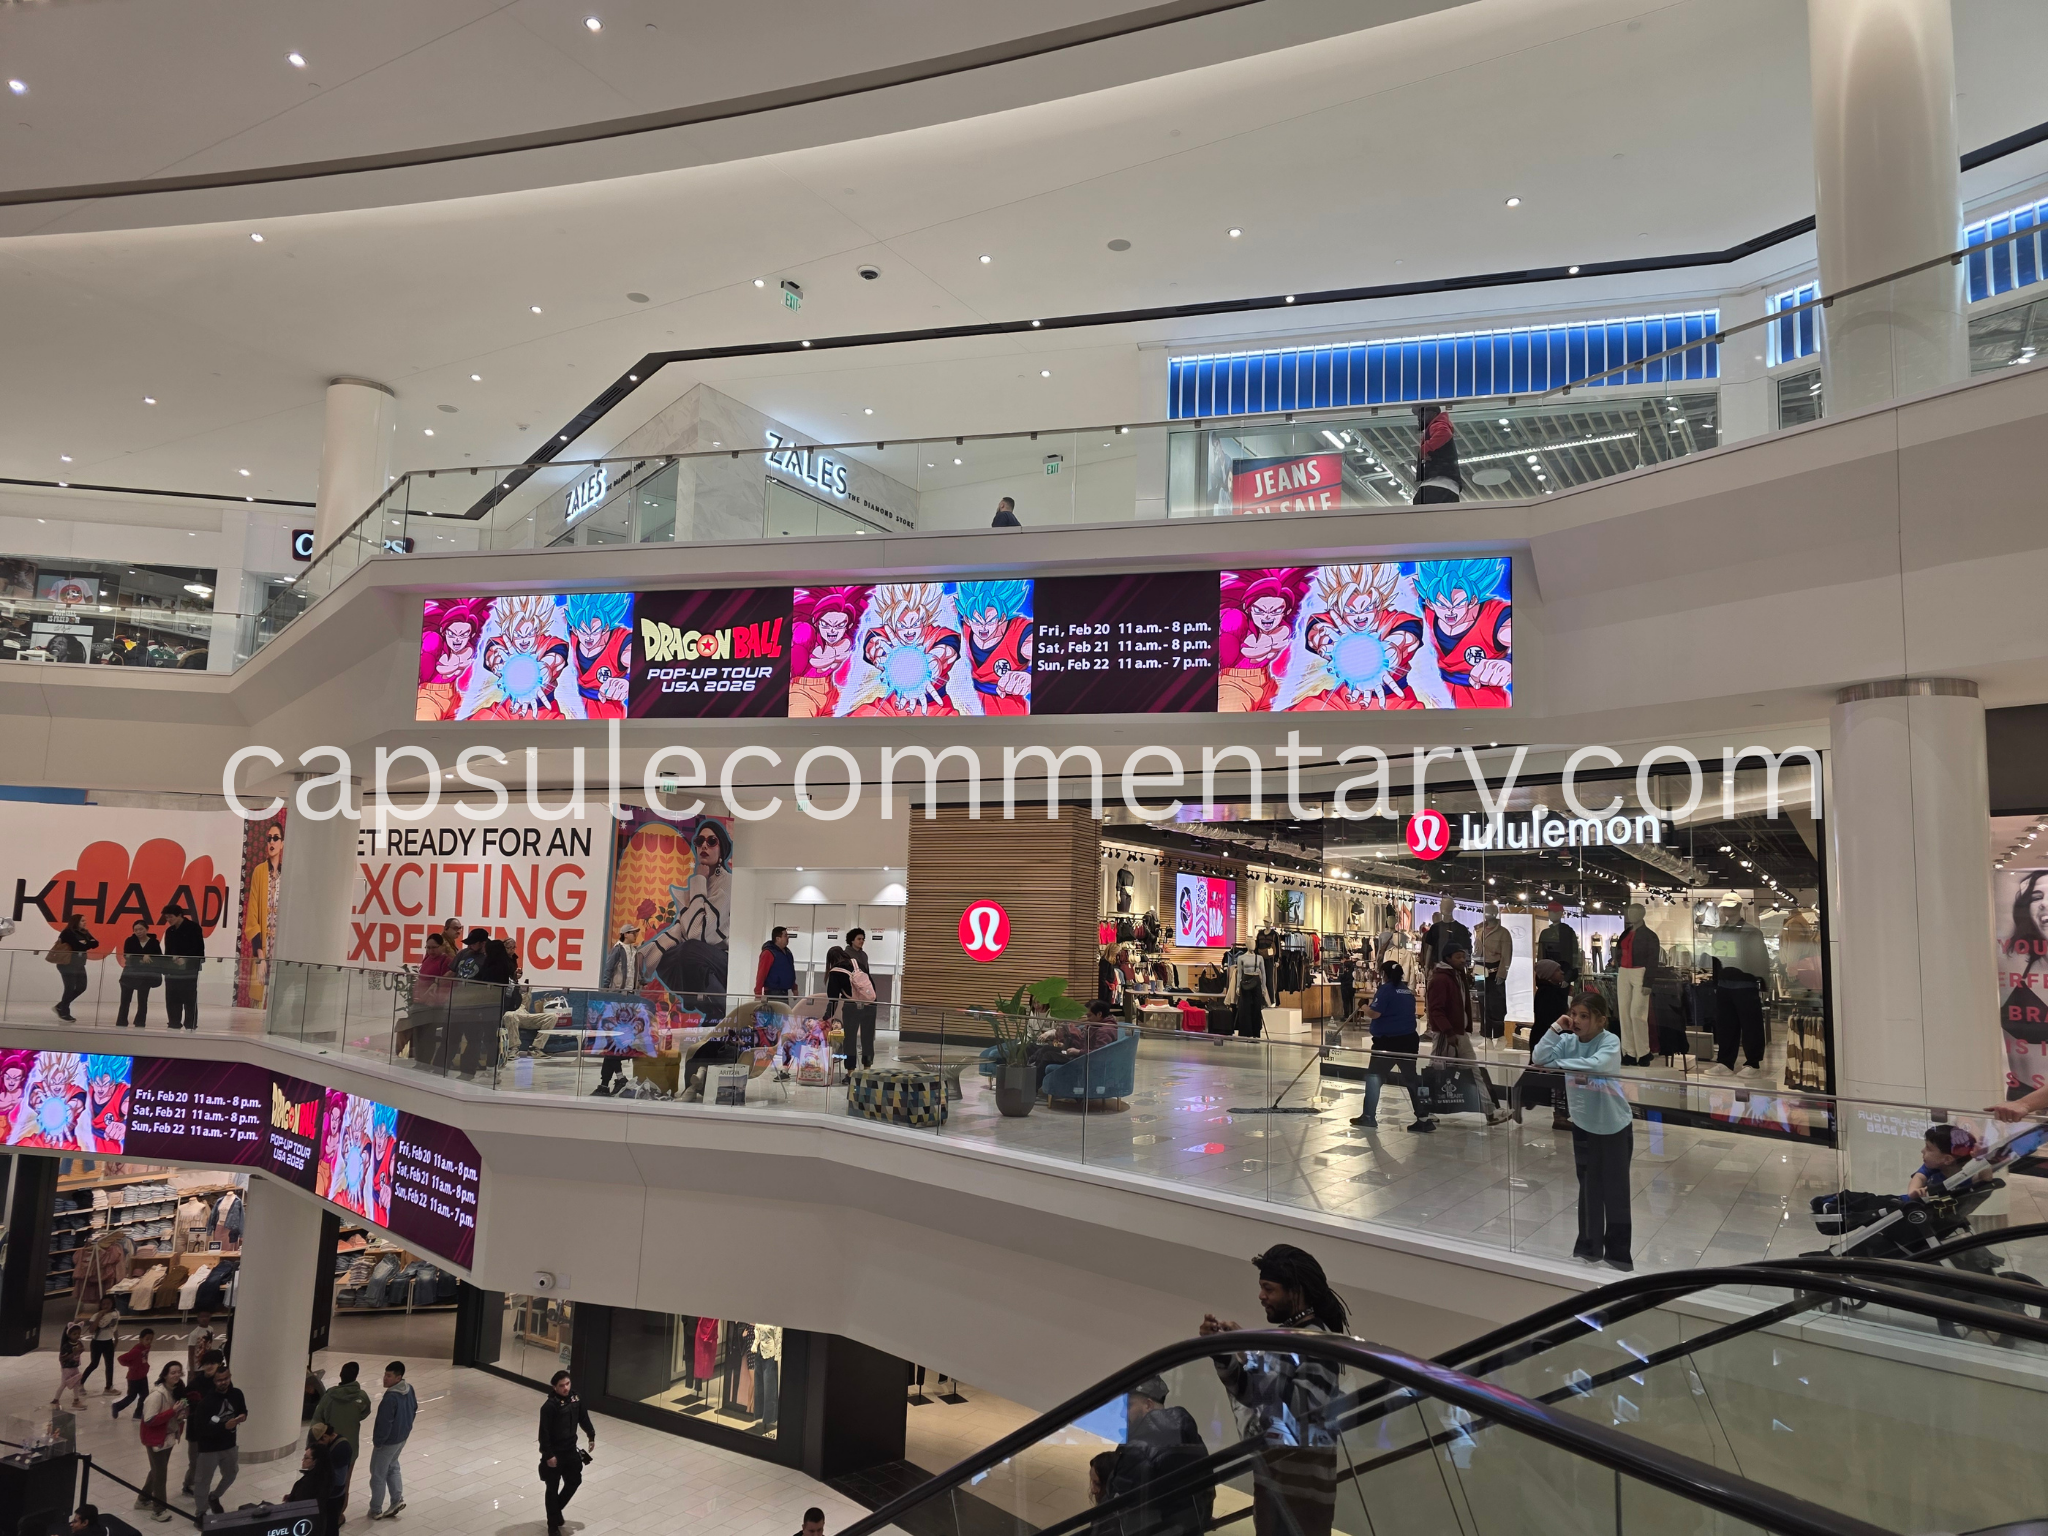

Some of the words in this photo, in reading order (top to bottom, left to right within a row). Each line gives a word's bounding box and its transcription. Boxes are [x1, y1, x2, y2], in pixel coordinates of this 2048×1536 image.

[785, 292, 798, 311] EXIT
[769, 431, 847, 494] ZALES
[848, 492, 860, 503] THE
[864, 500, 893, 519] DIAMOND
[1047, 463, 1059, 475] EXIT
[1254, 460, 1321, 498] JEANS
[564, 468, 603, 520] ZALES
[641, 617, 731, 661] DRAGON
[732, 617, 783, 659] BALL
[1039, 624, 1065, 638] Fri,
[1069, 623, 1092, 636] Feb
[1093, 623, 1110, 635] 20
[1118, 622, 1132, 634] 11
[1135, 624, 1162, 634] a.m.
[1171, 621, 1180, 632] 8
[1183, 622, 1211, 635] p.m.
[1037, 642, 1065, 655] Sat,
[1068, 641, 1091, 653] Feb
[1093, 641, 1108, 652] 21
[1118, 640, 1132, 651] 11
[1134, 641, 1162, 651] a.m.
[1171, 639, 1180, 650] 8
[1183, 640, 1211, 652] p.m.
[647, 667, 718, 680] POP-UP
[721, 666, 773, 679] TOUR
[1037, 660, 1065, 672] Sun,
[1067, 658, 1091, 670] Feb
[1093, 658, 1109, 670] 22
[1118, 658, 1132, 669] 11
[1134, 659, 1162, 669] a.m.
[1172, 656, 1181, 668] 7
[1183, 657, 1211, 670] p.m.
[661, 681, 700, 693] USA
[704, 680, 756, 692] 2026
[356, 828, 381, 856] ET
[387, 827, 476, 857] READY
[482, 827, 541, 857] FOR
[545, 827, 592, 857] AN
[1462, 810, 1664, 850] lululemon
[12, 878, 230, 929] KHAADI
[351, 862, 588, 920] XCITING
[347, 922, 586, 971] XPENCE
[1999, 972, 2048, 989] ERF
[2008, 1005, 2048, 1023] BR
[135, 1089, 155, 1102] Fri,
[157, 1090, 175, 1102] Feb
[175, 1092, 188, 1102] 20
[194, 1093, 204, 1104] 11
[205, 1096, 226, 1106] a.m.
[232, 1096, 239, 1106] 8
[240, 1098, 261, 1109] p.m.
[271, 1081, 300, 1134] DRAGON
[298, 1099, 319, 1140] BALL
[133, 1105, 153, 1117] Sat,
[155, 1106, 173, 1118] Feb
[174, 1108, 186, 1118] 21
[192, 1109, 203, 1120] 11
[204, 1112, 224, 1121] a.m.
[230, 1112, 237, 1122] 8
[238, 1114, 260, 1126] p.m.
[131, 1121, 152, 1133] Sun,
[153, 1122, 171, 1134] Feb
[172, 1124, 185, 1134] 22
[190, 1125, 201, 1136] 11
[202, 1128, 223, 1138] a.m.
[229, 1128, 237, 1139] 7
[237, 1131, 258, 1141] p.m.
[270, 1133, 293, 1151] POP-UP
[293, 1142, 311, 1159] TOUR
[273, 1147, 286, 1163] USA
[286, 1154, 305, 1171] 2026
[399, 1140, 411, 1158] Fri,
[411, 1144, 423, 1161] Feb
[422, 1149, 431, 1164] 20
[433, 1153, 441, 1168] 11
[441, 1158, 454, 1173] a.m.
[458, 1162, 463, 1176] 8
[463, 1166, 478, 1181] p.m.
[396, 1161, 409, 1180] Sat,
[410, 1166, 421, 1183] Feb
[420, 1171, 429, 1186] 21
[432, 1175, 439, 1190] 11
[439, 1180, 453, 1195] a.m.
[456, 1184, 461, 1199] 8
[461, 1189, 476, 1205] p.m.
[394, 1182, 407, 1201] Sun,
[407, 1187, 419, 1204] Feb
[418, 1192, 427, 1208] 22
[430, 1197, 438, 1212] 11
[437, 1202, 451, 1218] a.m.
[454, 1207, 460, 1222] 7
[459, 1212, 474, 1228] p.m.
[267, 1528, 290, 1536] LEVEL
[300, 1523, 306, 1534] 1
